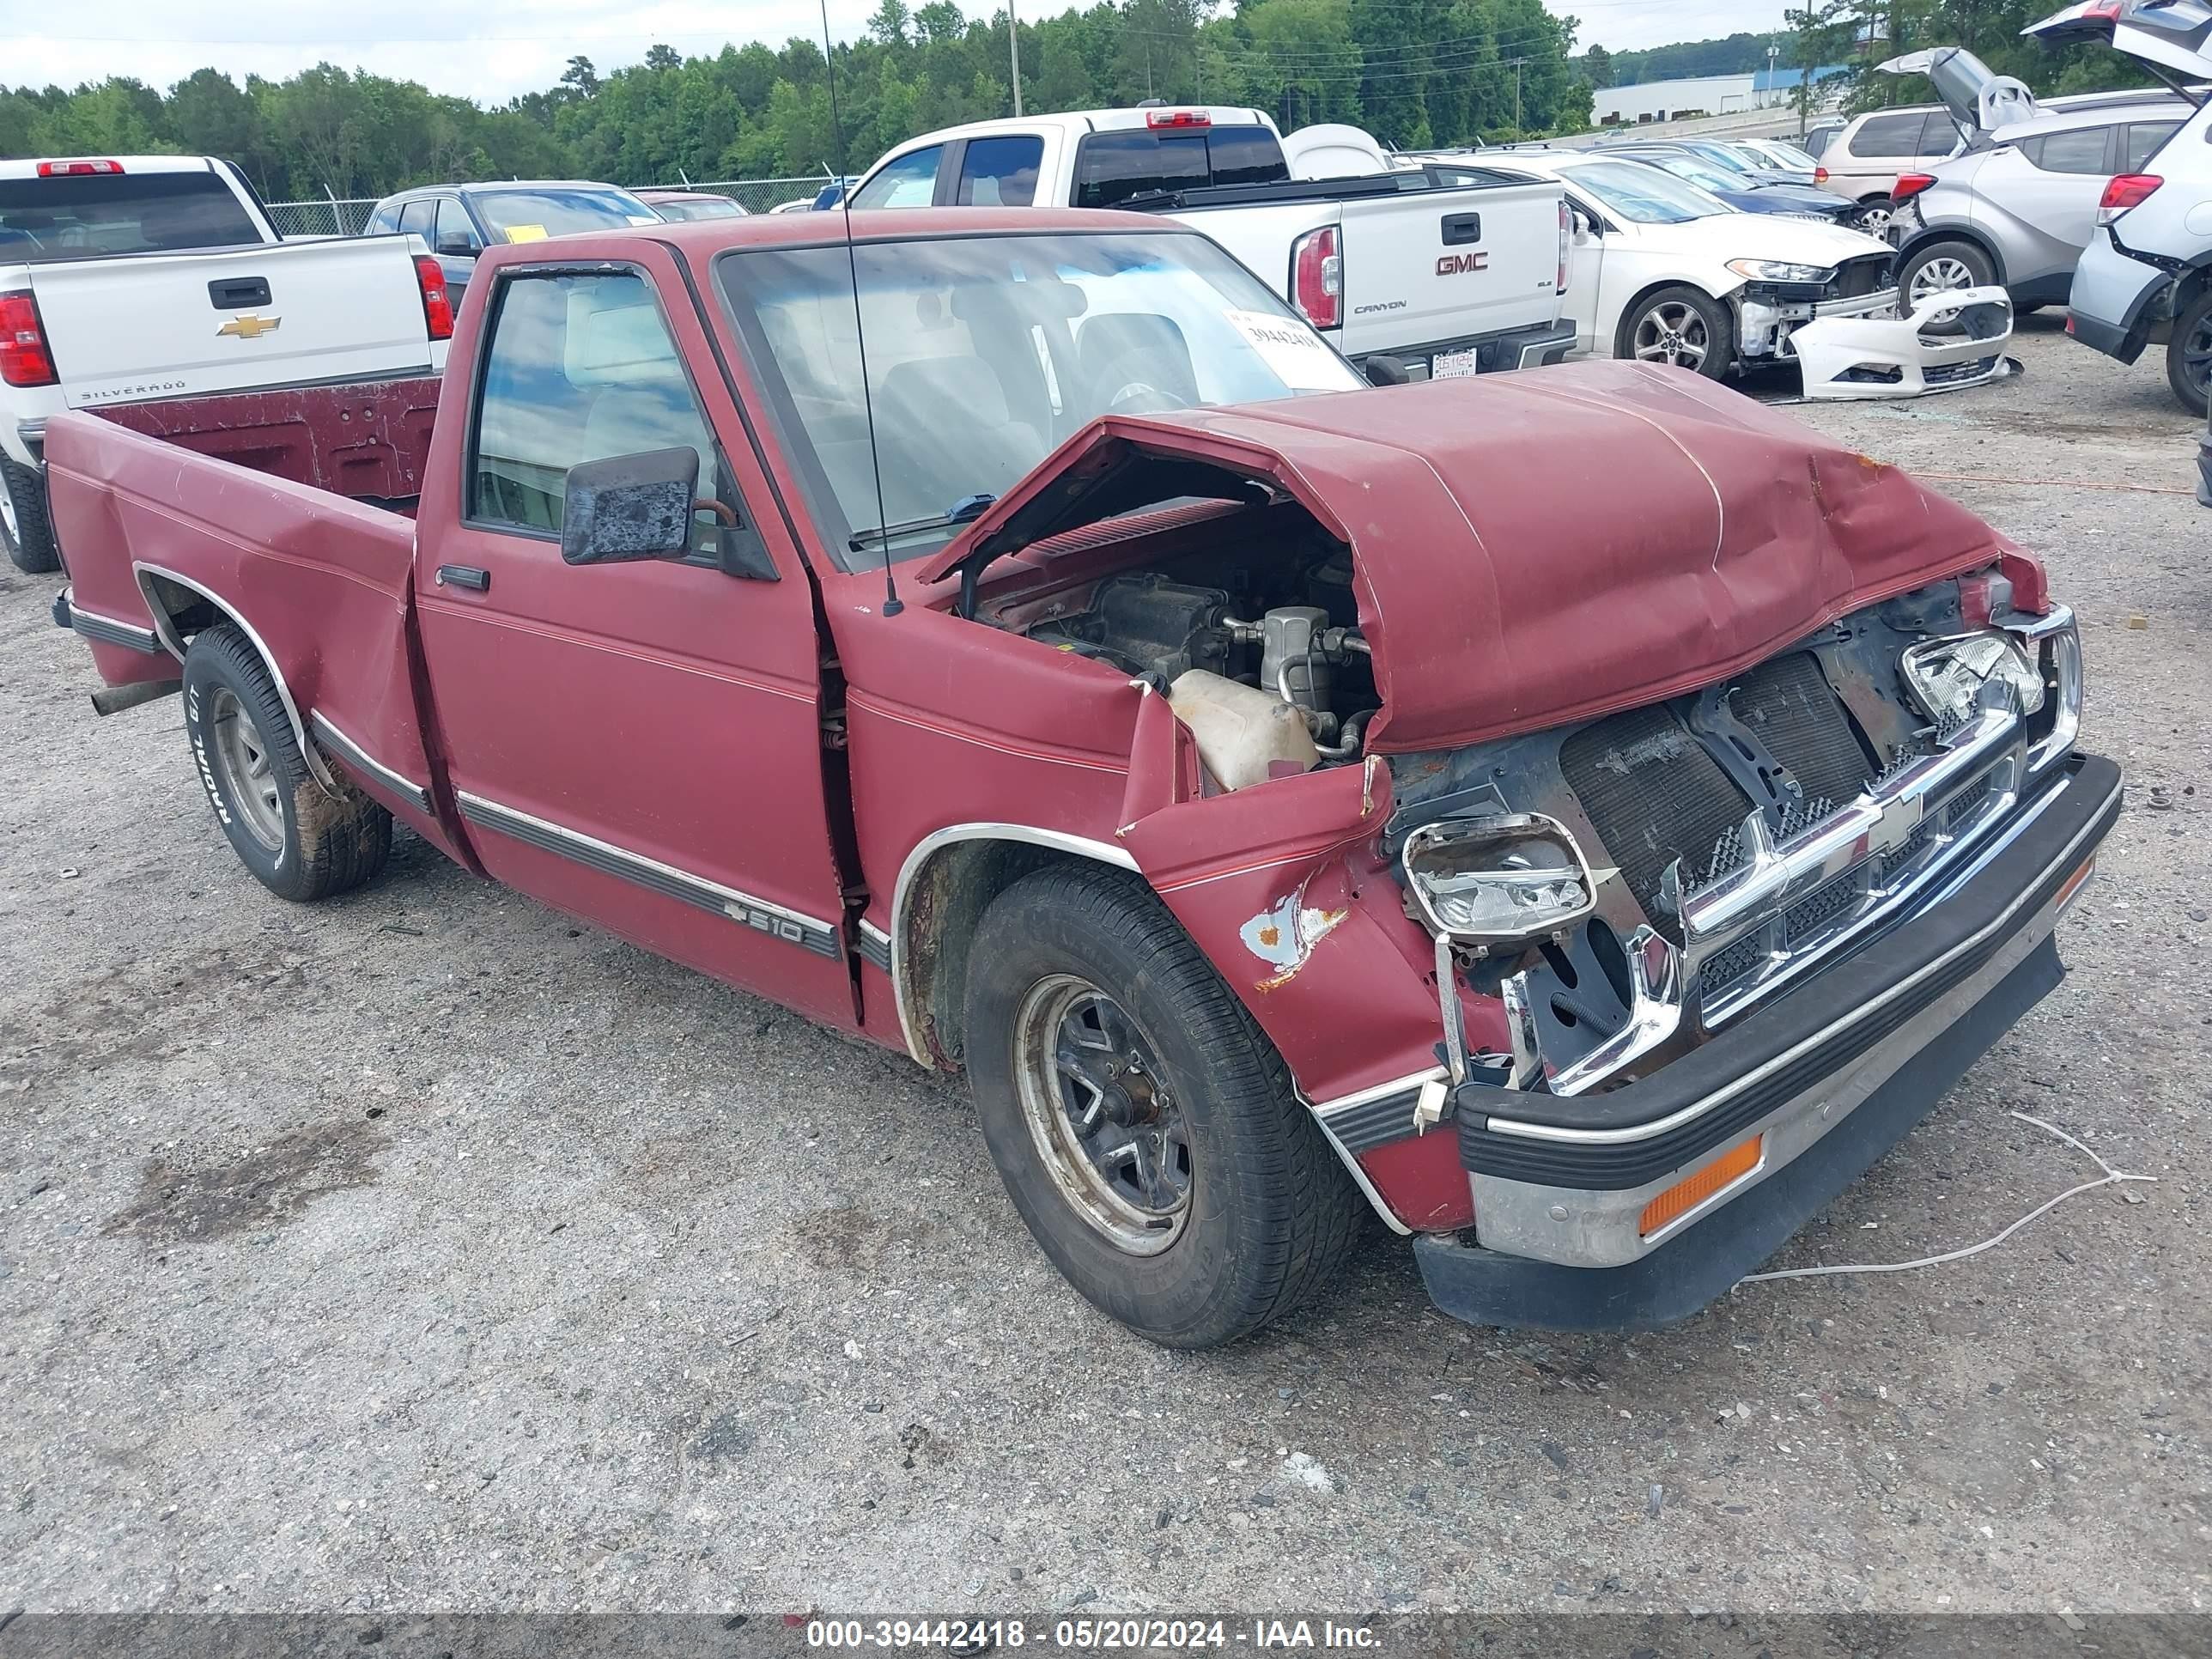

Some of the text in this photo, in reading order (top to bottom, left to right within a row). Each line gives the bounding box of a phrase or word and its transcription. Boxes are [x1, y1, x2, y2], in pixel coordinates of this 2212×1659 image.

[1436, 252, 1488, 276] GMC
[1353, 300, 1407, 314] CANYON
[1248, 327, 1320, 349] 39442418
[82, 380, 186, 400] SILVERADO
[188, 684, 232, 824] RADIAL G/T
[750, 910, 802, 942] S10
